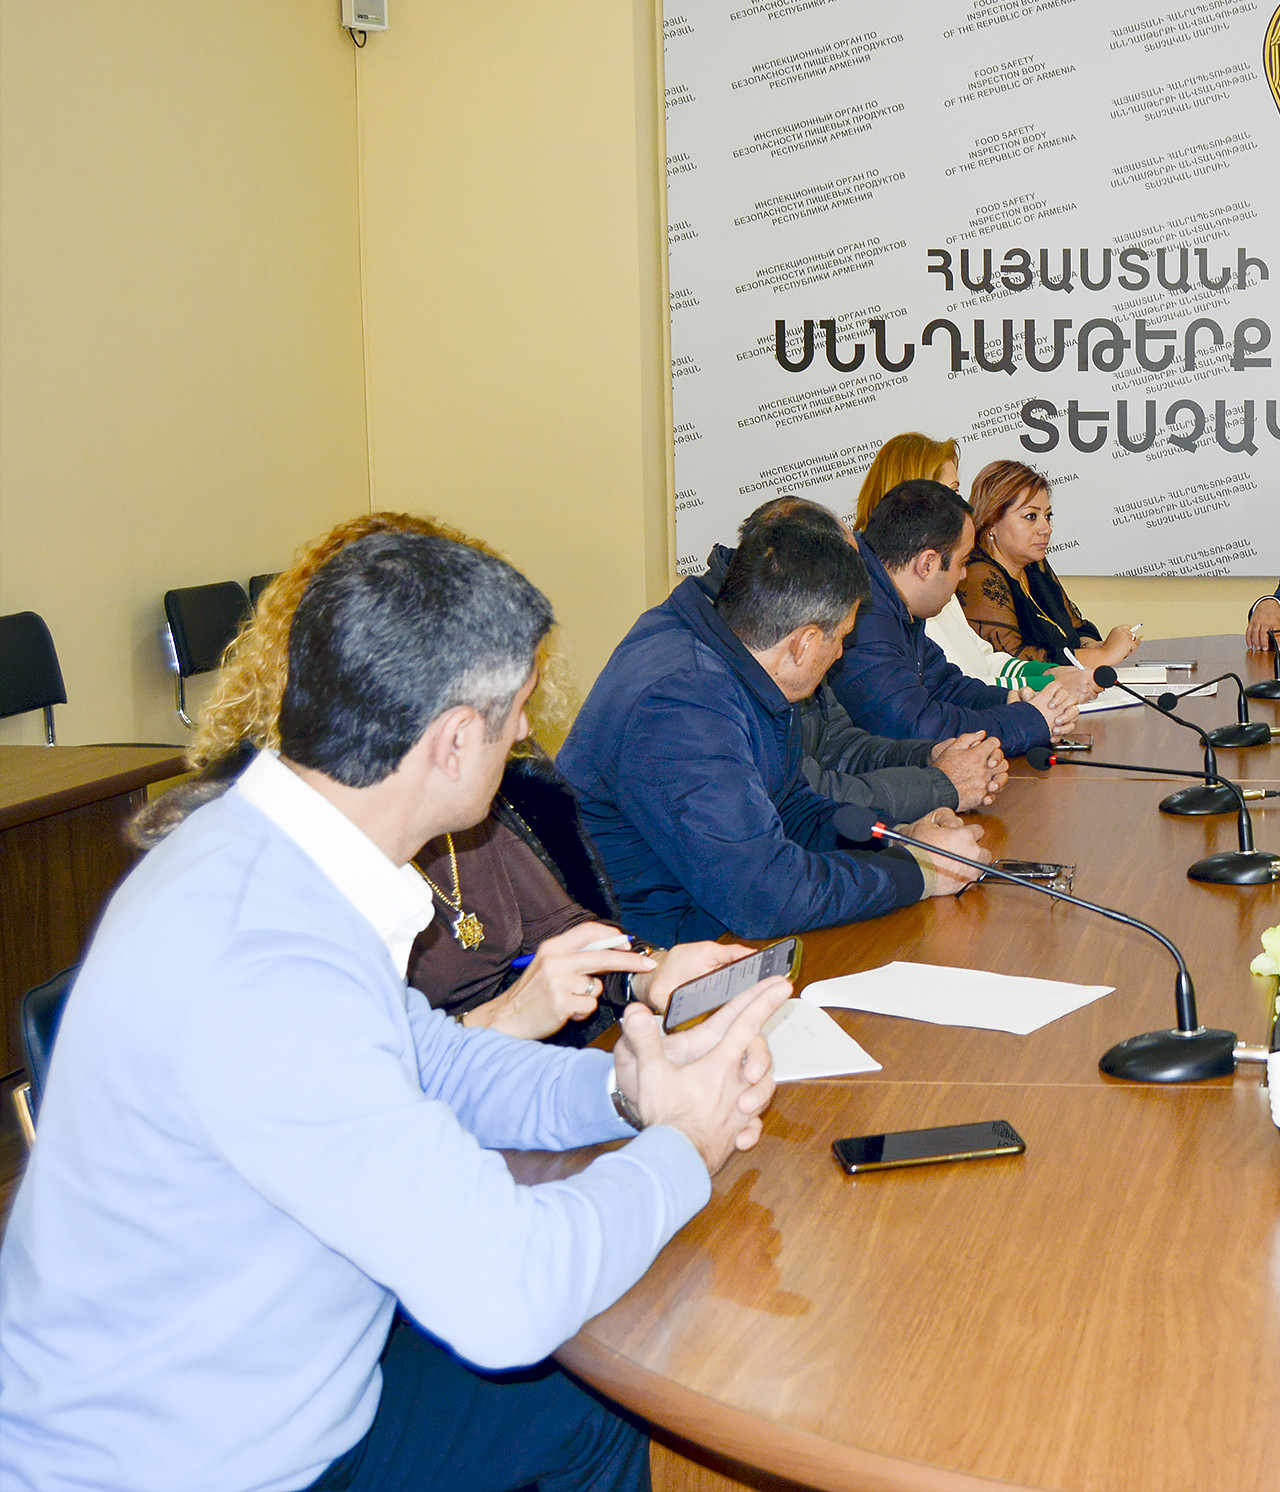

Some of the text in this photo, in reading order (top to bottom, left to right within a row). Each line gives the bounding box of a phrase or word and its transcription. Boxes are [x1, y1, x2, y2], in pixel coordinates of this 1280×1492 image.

[944, 64, 1077, 108] OF THE REPUBLIC OF ARMENIA
[968, 62, 1046, 90] INSPECTION BODY
[974, 55, 1034, 78] FOOD SAFETY
[1111, 62, 1251, 107] ՀԱՅԱՍՏԱՆԻ ՀԱՆՐԱՊԵՏՈՒԹՅԱՆ
[1110, 72, 1258, 120] ՍՆՆԴԱՄԹԵՐՔԻ ԱՆՎՏԱՆԳՈՒԹՅԱՆ
[1144, 92, 1230, 122] ՏԵՍՉԱԿԱՆ ՄԱՐՄԻՆ
[732, 103, 905, 158] БЕЗОПАСНОСТИ ПИЩЕВЫХ ПРОДУКТОВ
[753, 100, 879, 142] ИНСПЕКЦИОННЫЙ ОРГАН ПО
[770, 123, 873, 158] РЕСПУБЛИКИ АРМЕНИЯ
[975, 124, 1035, 147] FOOD SAFETY
[945, 133, 1078, 177] OF THE REPUBLIC OF ARMENIA
[969, 131, 1047, 159] INSPECTION BODY
[1110, 141, 1258, 189] ՍՆՆԴԱՄԹԵՐՔԻ ԱՆՎՏԱՆԳՈՒԹՅԱՆ
[1111, 131, 1251, 176] ՀԱՅԱՍՏԱՆԻ ՀԱՆՐԱՊԵՏՈՒԹՅԱՆ
[754, 169, 880, 210] ИНСПЕКЦИОННЫЙ ОРГАН ПО
[1144, 161, 1230, 191] ՏԵՍՉԱԿԱՆ ՄԱՐՄԻՆ
[733, 172, 906, 226] БЕЗОПАСНОСТИ ПИЩЕВЫХ ПРОДУКТОВ
[771, 191, 874, 226] РЕСПУБЛИКИ АРМЕНИЯ
[969, 199, 1047, 227] INSPECTION BODY
[975, 192, 1035, 215] FOOD SAFETY
[946, 201, 1078, 245] OF THE REPUBLIC OF ARMENIA
[734, 240, 907, 294] БЕЗОПАСНОСТИ ПИЩЕВЫХ ПРОДУКТОВ
[755, 237, 881, 278] ИНСПЕКЦИОННЫЙ ОРГАН ПО
[772, 259, 875, 294] РЕСПУБЛИКИ АРМЕНИЯ
[927, 247, 1270, 295] ՀԱՅԱՍՏԱՆԻ
[737, 375, 909, 429] БЕЗОПАСНОСТИ ПИЩЕВЫХ ПРОДУКТОВ
[758, 372, 883, 413] ИНСПЕКЦИОННЫЙ ОРГАН ПО
[775, 394, 877, 429] РЕСПУБЛИКИ АРМЕНИЯ
[1112, 481, 1259, 528] ՍՆՆԴԱՄԹԵՐՔԻ ԱՆՎՏԱՆԳՈՒԹՅԱՆ
[1113, 471, 1252, 515] ՀԱՅԱՍՏԱՆԻ ՀԱՆՐԱՊԵՏՈՒԹՅԱՆ
[1145, 501, 1231, 529] ՏԵՍՉԱԿԱՆ ՄԱՐՄԻՆ
